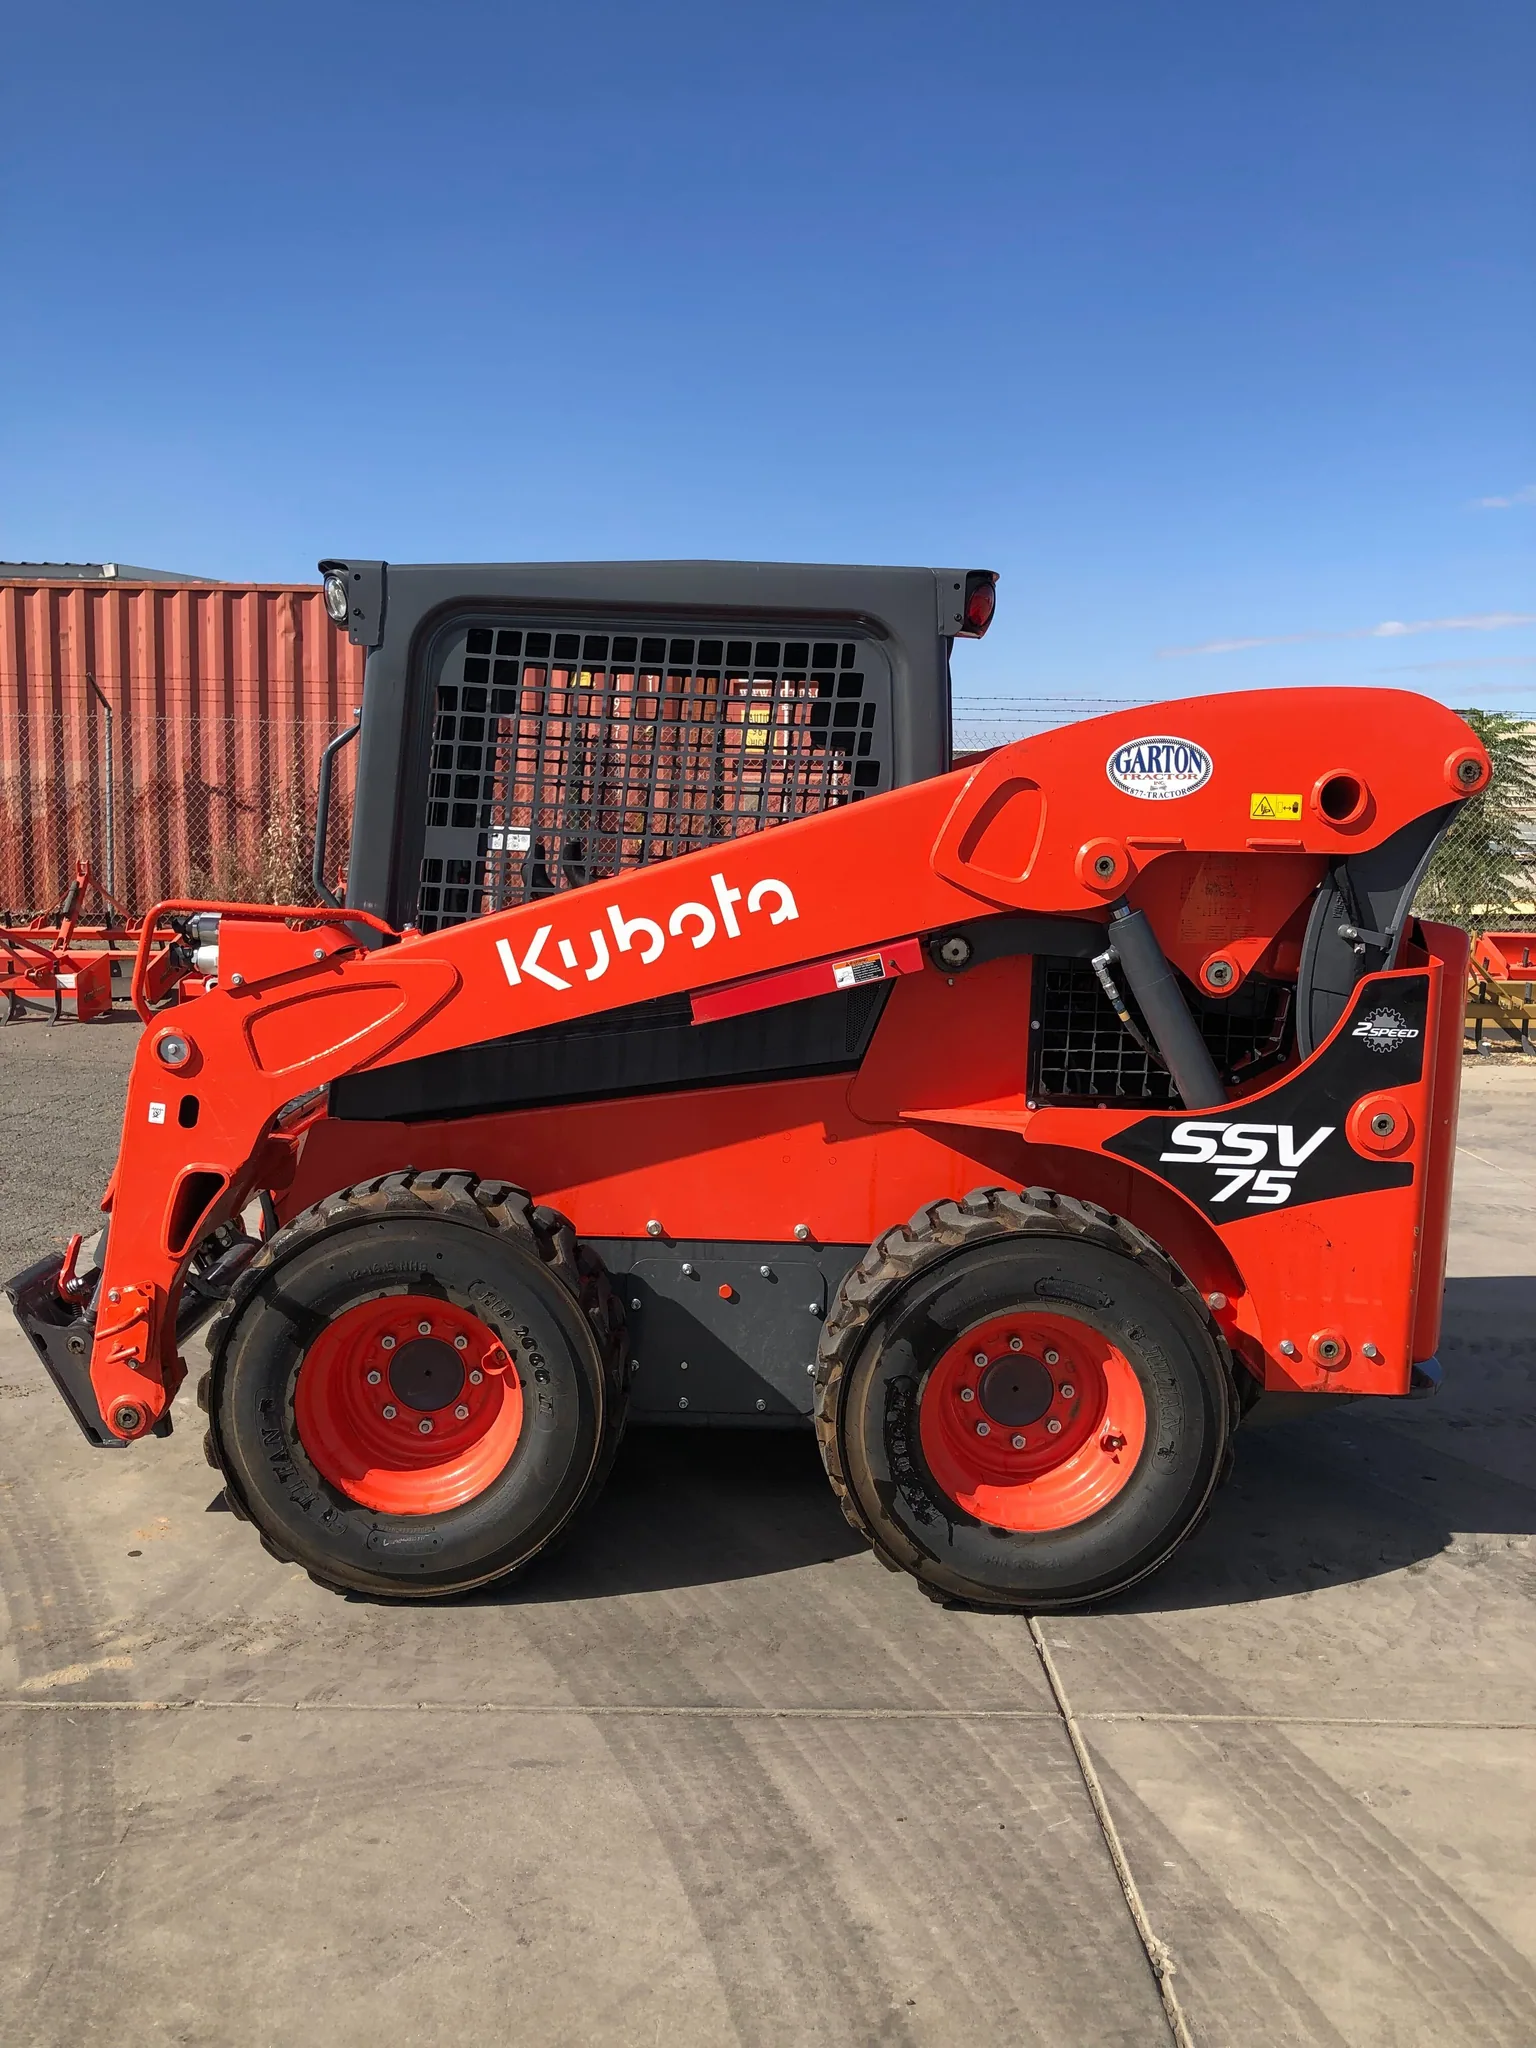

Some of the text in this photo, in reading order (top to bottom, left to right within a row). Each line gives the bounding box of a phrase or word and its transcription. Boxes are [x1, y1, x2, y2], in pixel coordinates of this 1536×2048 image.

[1115, 744, 1204, 774] GARTON
[1120, 773, 1199, 781] TRACTOR
[495, 872, 799, 991] Kubota
[1159, 1121, 1336, 1167] SSV
[1209, 1167, 1298, 1205] 75
[261, 1427, 320, 1513] TITAN
